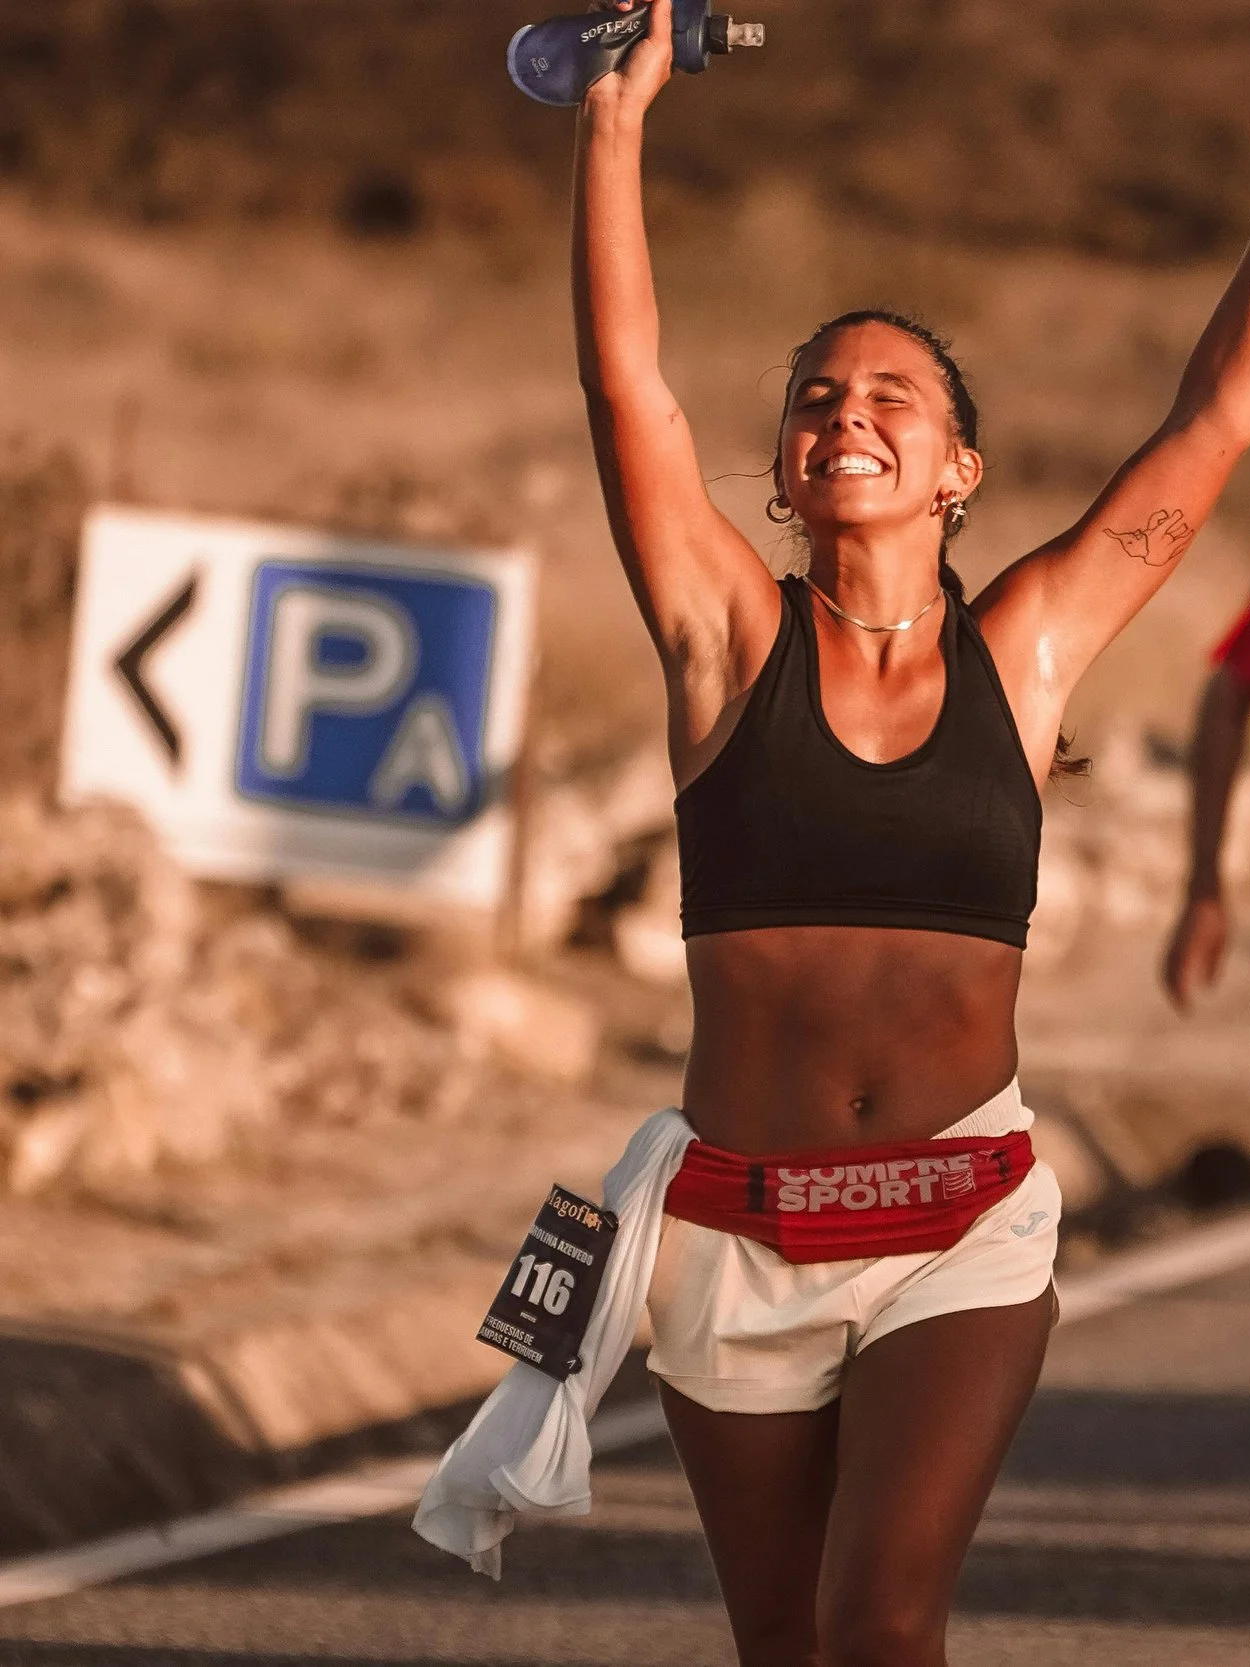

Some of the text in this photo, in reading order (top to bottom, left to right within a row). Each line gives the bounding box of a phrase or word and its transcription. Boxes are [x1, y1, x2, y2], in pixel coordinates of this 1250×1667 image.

[776, 1174, 940, 1213] SPORT
[557, 1240, 594, 1266] AZEVEDO
[510, 1254, 575, 1316] 116
[502, 1337, 509, 1347] E
[508, 1339, 544, 1364] TERRUGEM
[523, 1333, 535, 1346] DE
